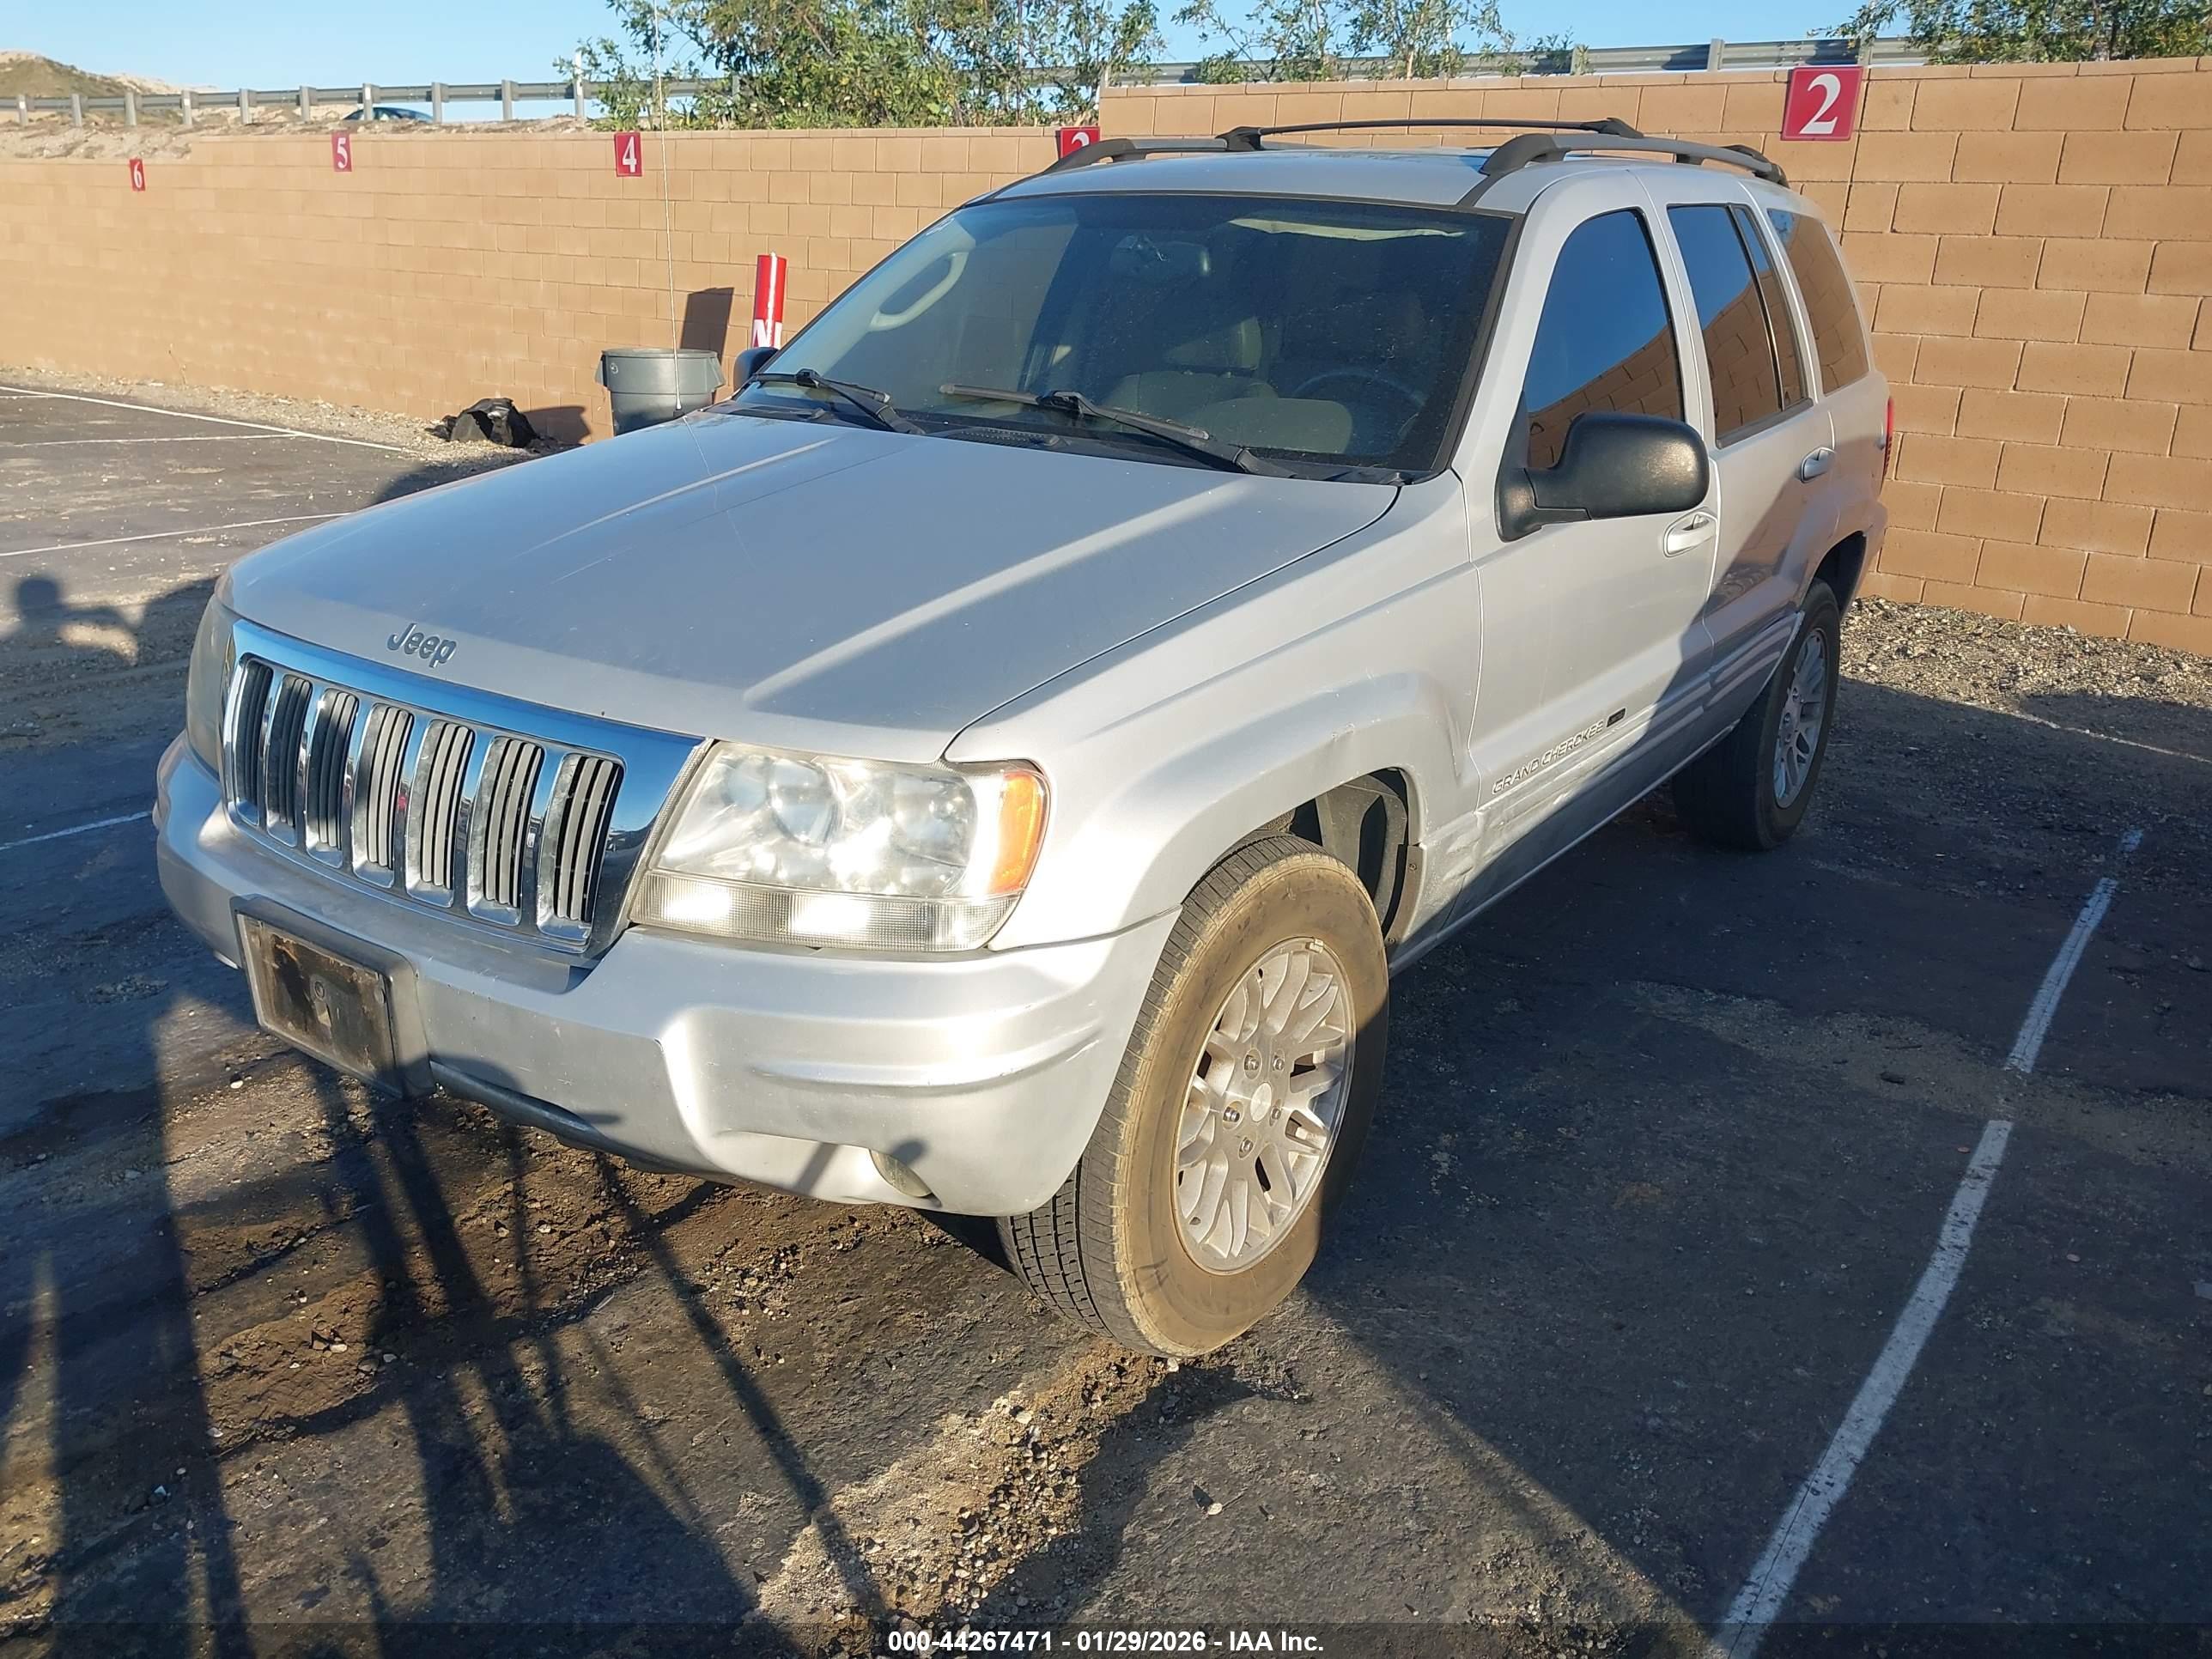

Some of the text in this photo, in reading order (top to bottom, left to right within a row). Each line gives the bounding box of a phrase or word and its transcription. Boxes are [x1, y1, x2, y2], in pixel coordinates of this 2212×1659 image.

[1799, 73, 1841, 134] 2
[337, 137, 348, 169] 5
[622, 136, 637, 173] 4
[133, 161, 143, 188] 6
[386, 623, 457, 668] Jeep
[1492, 720, 1604, 794] GRAND CHEROKEE
